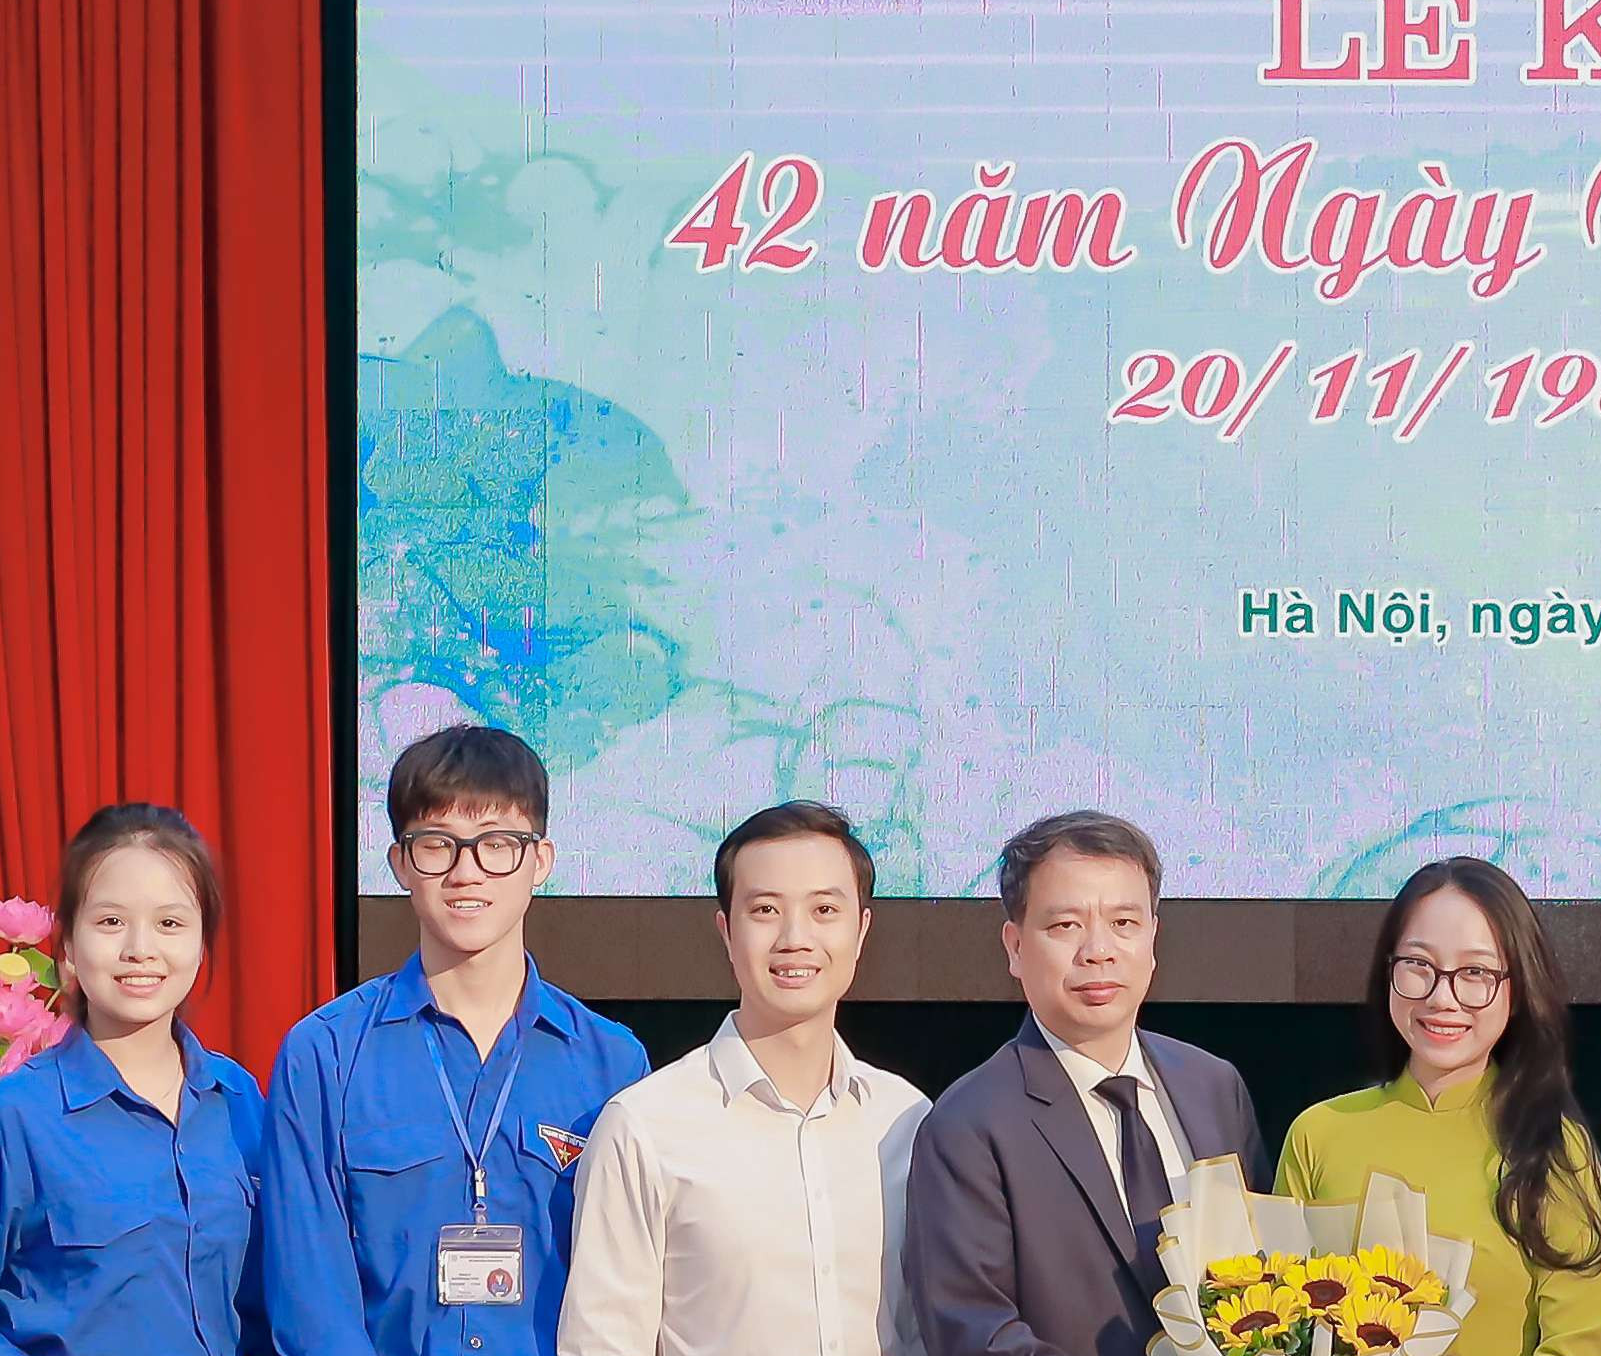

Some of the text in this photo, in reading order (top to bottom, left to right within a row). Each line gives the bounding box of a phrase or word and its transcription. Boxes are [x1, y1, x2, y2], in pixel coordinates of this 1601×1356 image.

[671, 159, 818, 269] 42
[862, 169, 1129, 269] năm
[1177, 141, 1539, 300] Ngày
[1242, 590, 1314, 634] Hà
[1338, 591, 1447, 644] Nội,
